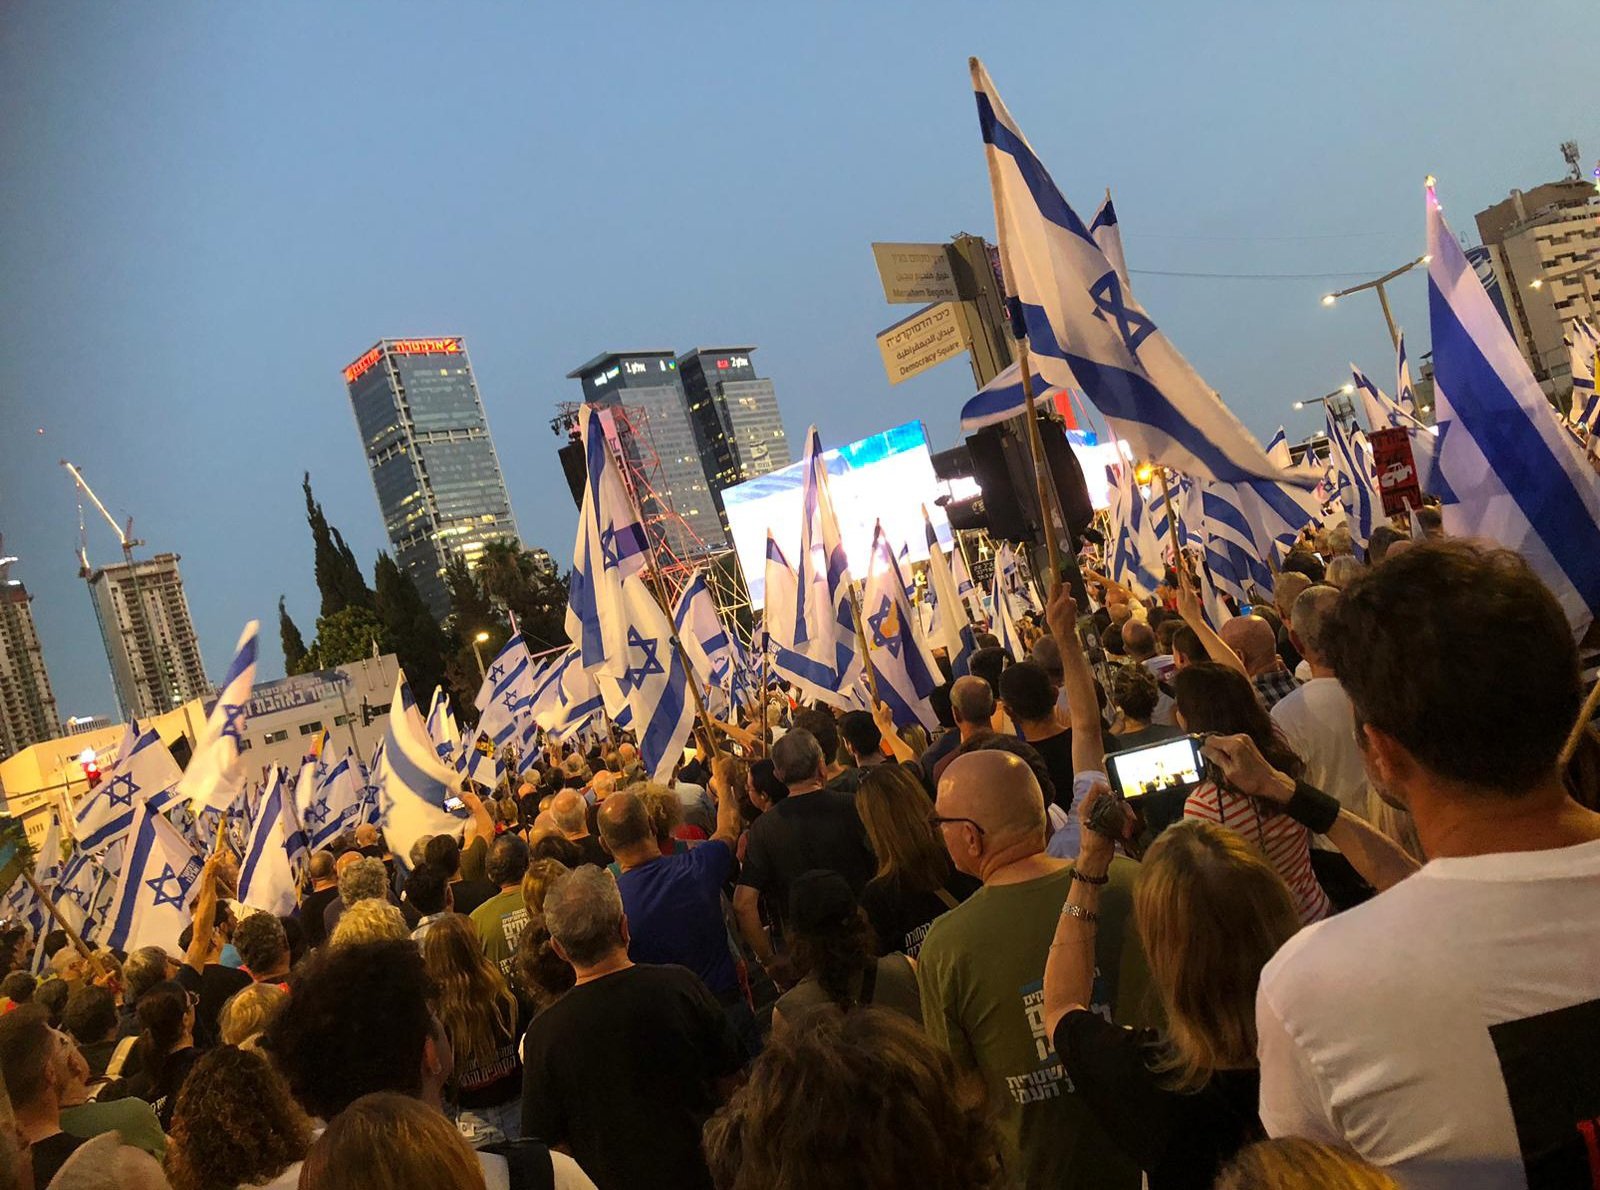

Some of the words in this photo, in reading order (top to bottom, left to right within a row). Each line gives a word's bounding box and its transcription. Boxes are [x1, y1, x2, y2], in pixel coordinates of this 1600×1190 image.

[933, 308, 950, 321] כיכר
[886, 317, 933, 348] הדמוקרטיה
[396, 340, 443, 353] אלקטרה
[899, 351, 937, 375] Democracy
[936, 342, 960, 358] Square
